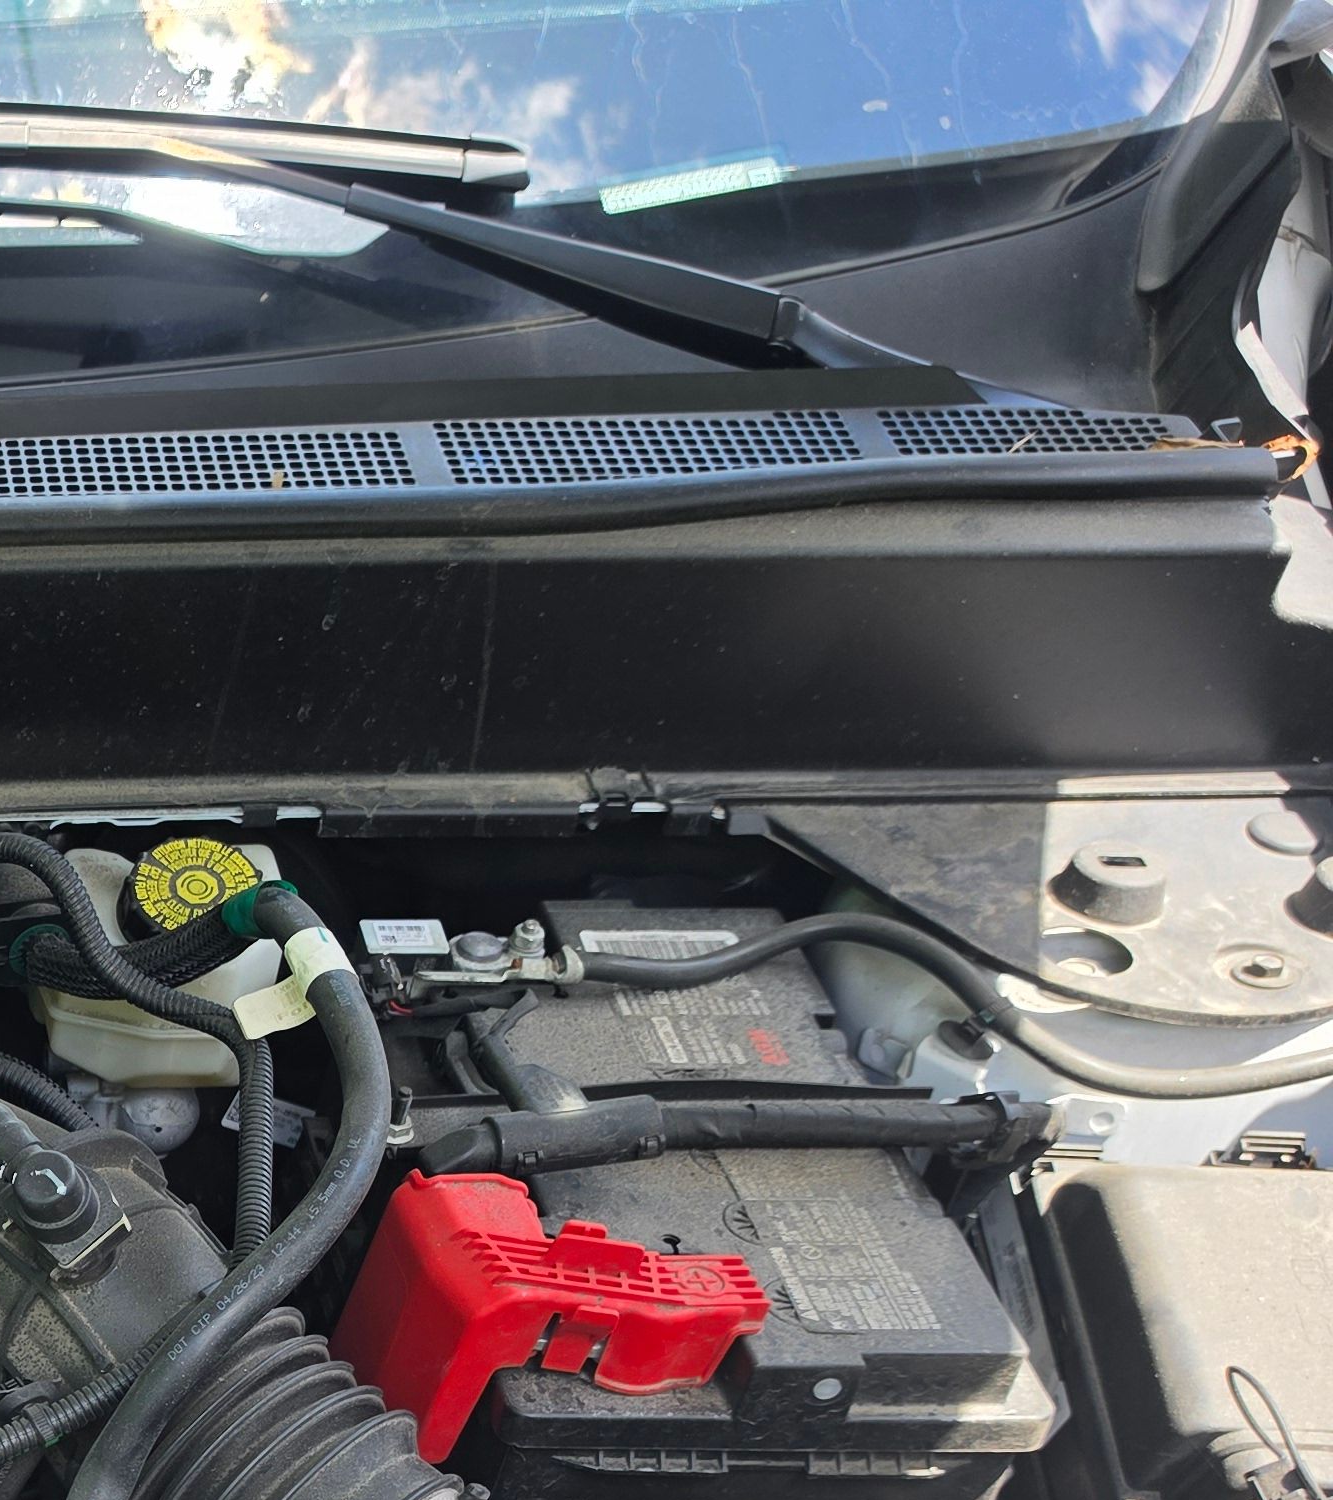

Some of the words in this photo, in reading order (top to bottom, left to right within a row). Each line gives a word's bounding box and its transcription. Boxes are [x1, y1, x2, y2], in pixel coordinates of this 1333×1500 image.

[166, 1336, 190, 1362] DOT
[190, 1312, 214, 1337] CIP
[215, 1262, 266, 1312] 04/26/23
